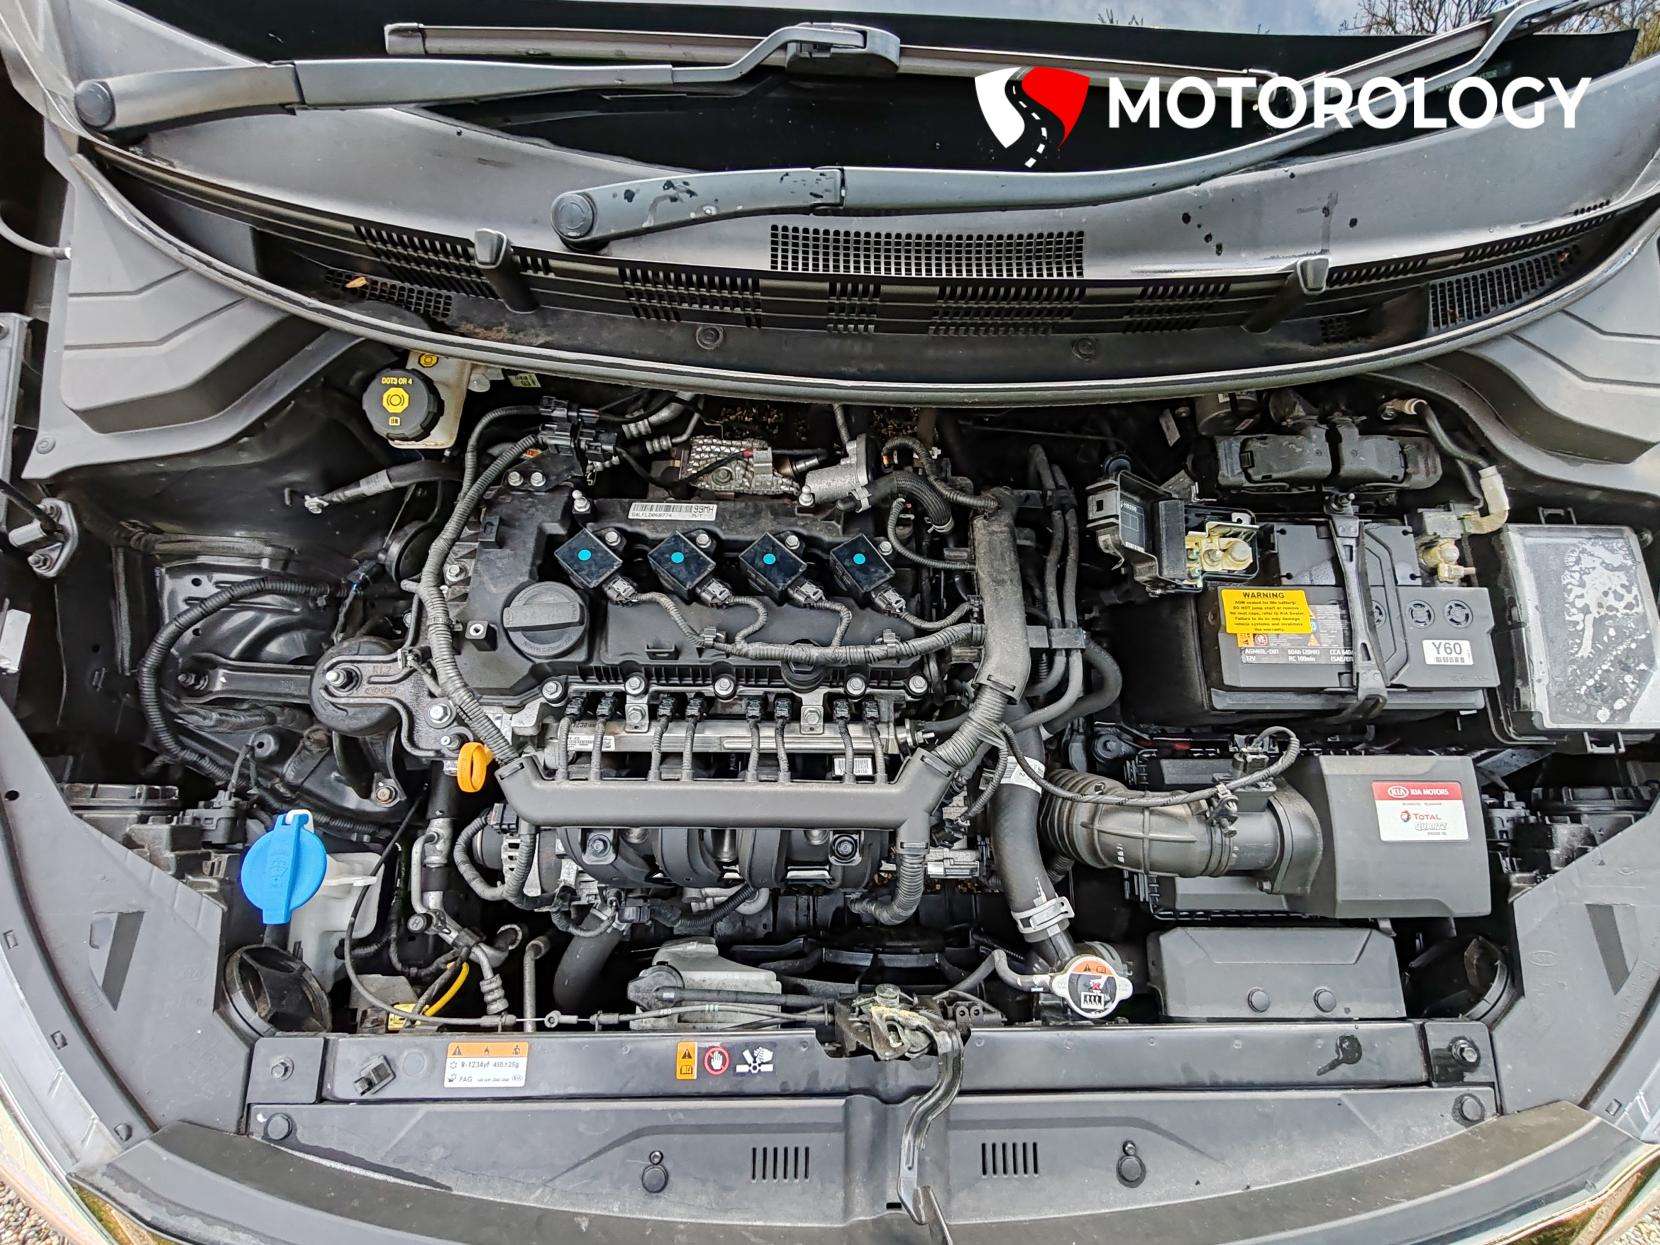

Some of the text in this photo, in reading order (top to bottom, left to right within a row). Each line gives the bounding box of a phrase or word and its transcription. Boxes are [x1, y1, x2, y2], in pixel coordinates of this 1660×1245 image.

[381, 377, 398, 385] DOT3
[398, 377, 408, 385] OR
[1432, 641, 1462, 655] Y60
[1422, 788, 1449, 796] MOTORS
